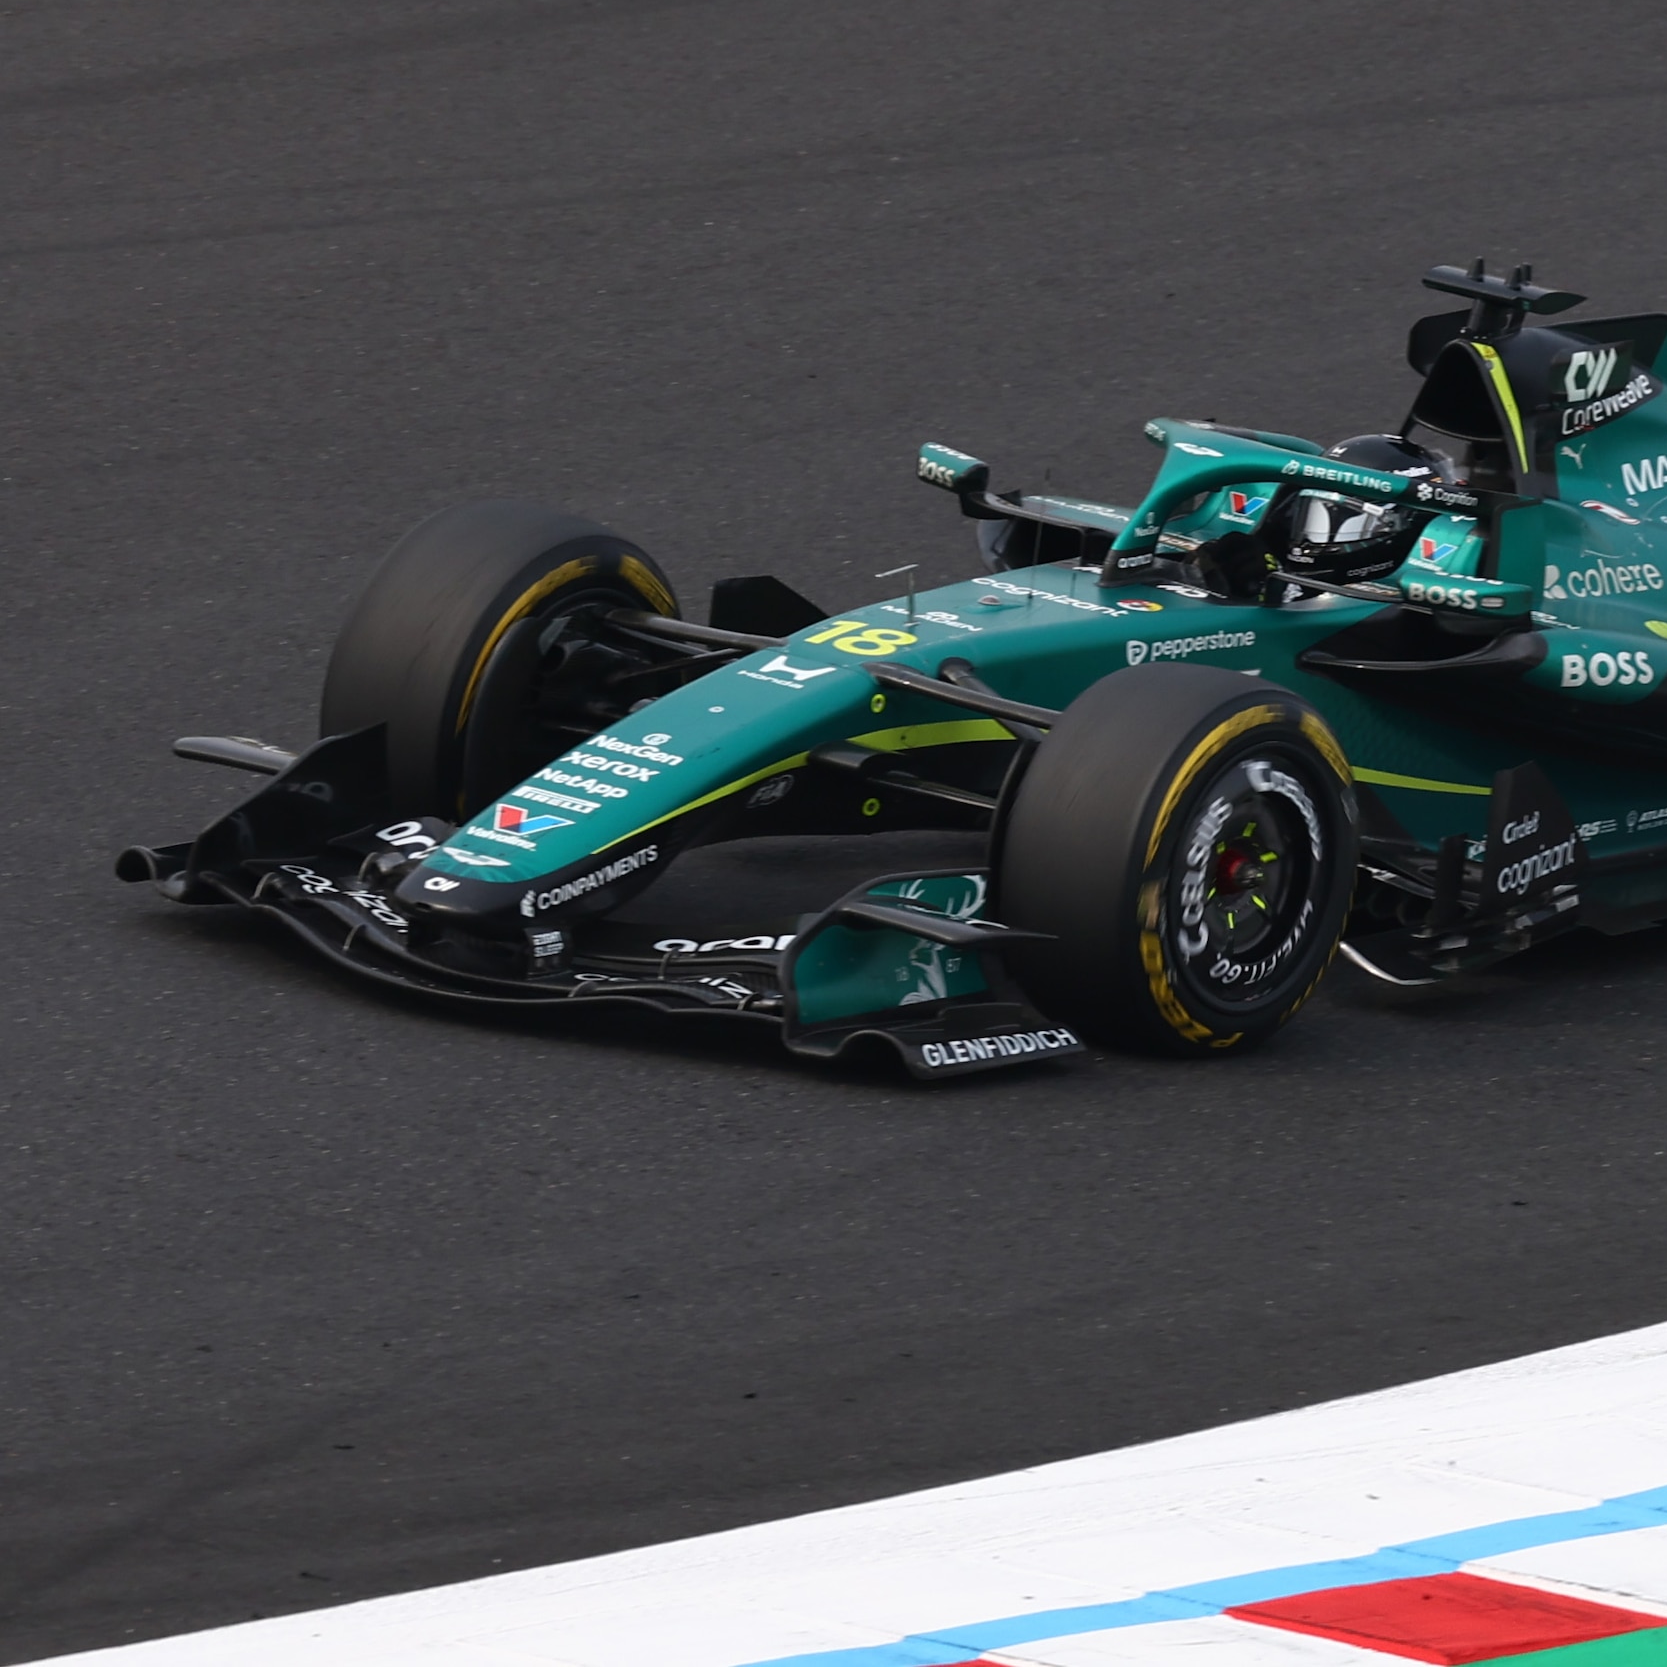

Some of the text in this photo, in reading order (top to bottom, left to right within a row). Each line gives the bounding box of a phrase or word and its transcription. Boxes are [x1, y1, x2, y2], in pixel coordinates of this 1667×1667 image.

[1561, 374, 1653, 436] CoreWeave
[1302, 464, 1393, 493] BREITLING
[1433, 486, 1479, 507] Cognition
[1408, 581, 1478, 610] BOSS
[1566, 559, 1665, 598] cohere
[971, 577, 1129, 618] cognizant
[804, 620, 919, 657] 18
[1150, 629, 1257, 662] pepperstone
[1560, 651, 1655, 688] BOSS
[559, 751, 661, 782] xerox
[586, 734, 685, 766] NexGen
[512, 785, 602, 814] PIRELLI
[533, 767, 629, 799] NetApp
[537, 844, 659, 911] COINPAYMENTS
[1497, 832, 1579, 896] cognizant
[921, 1028, 1079, 1068] GLENFIDDICH
